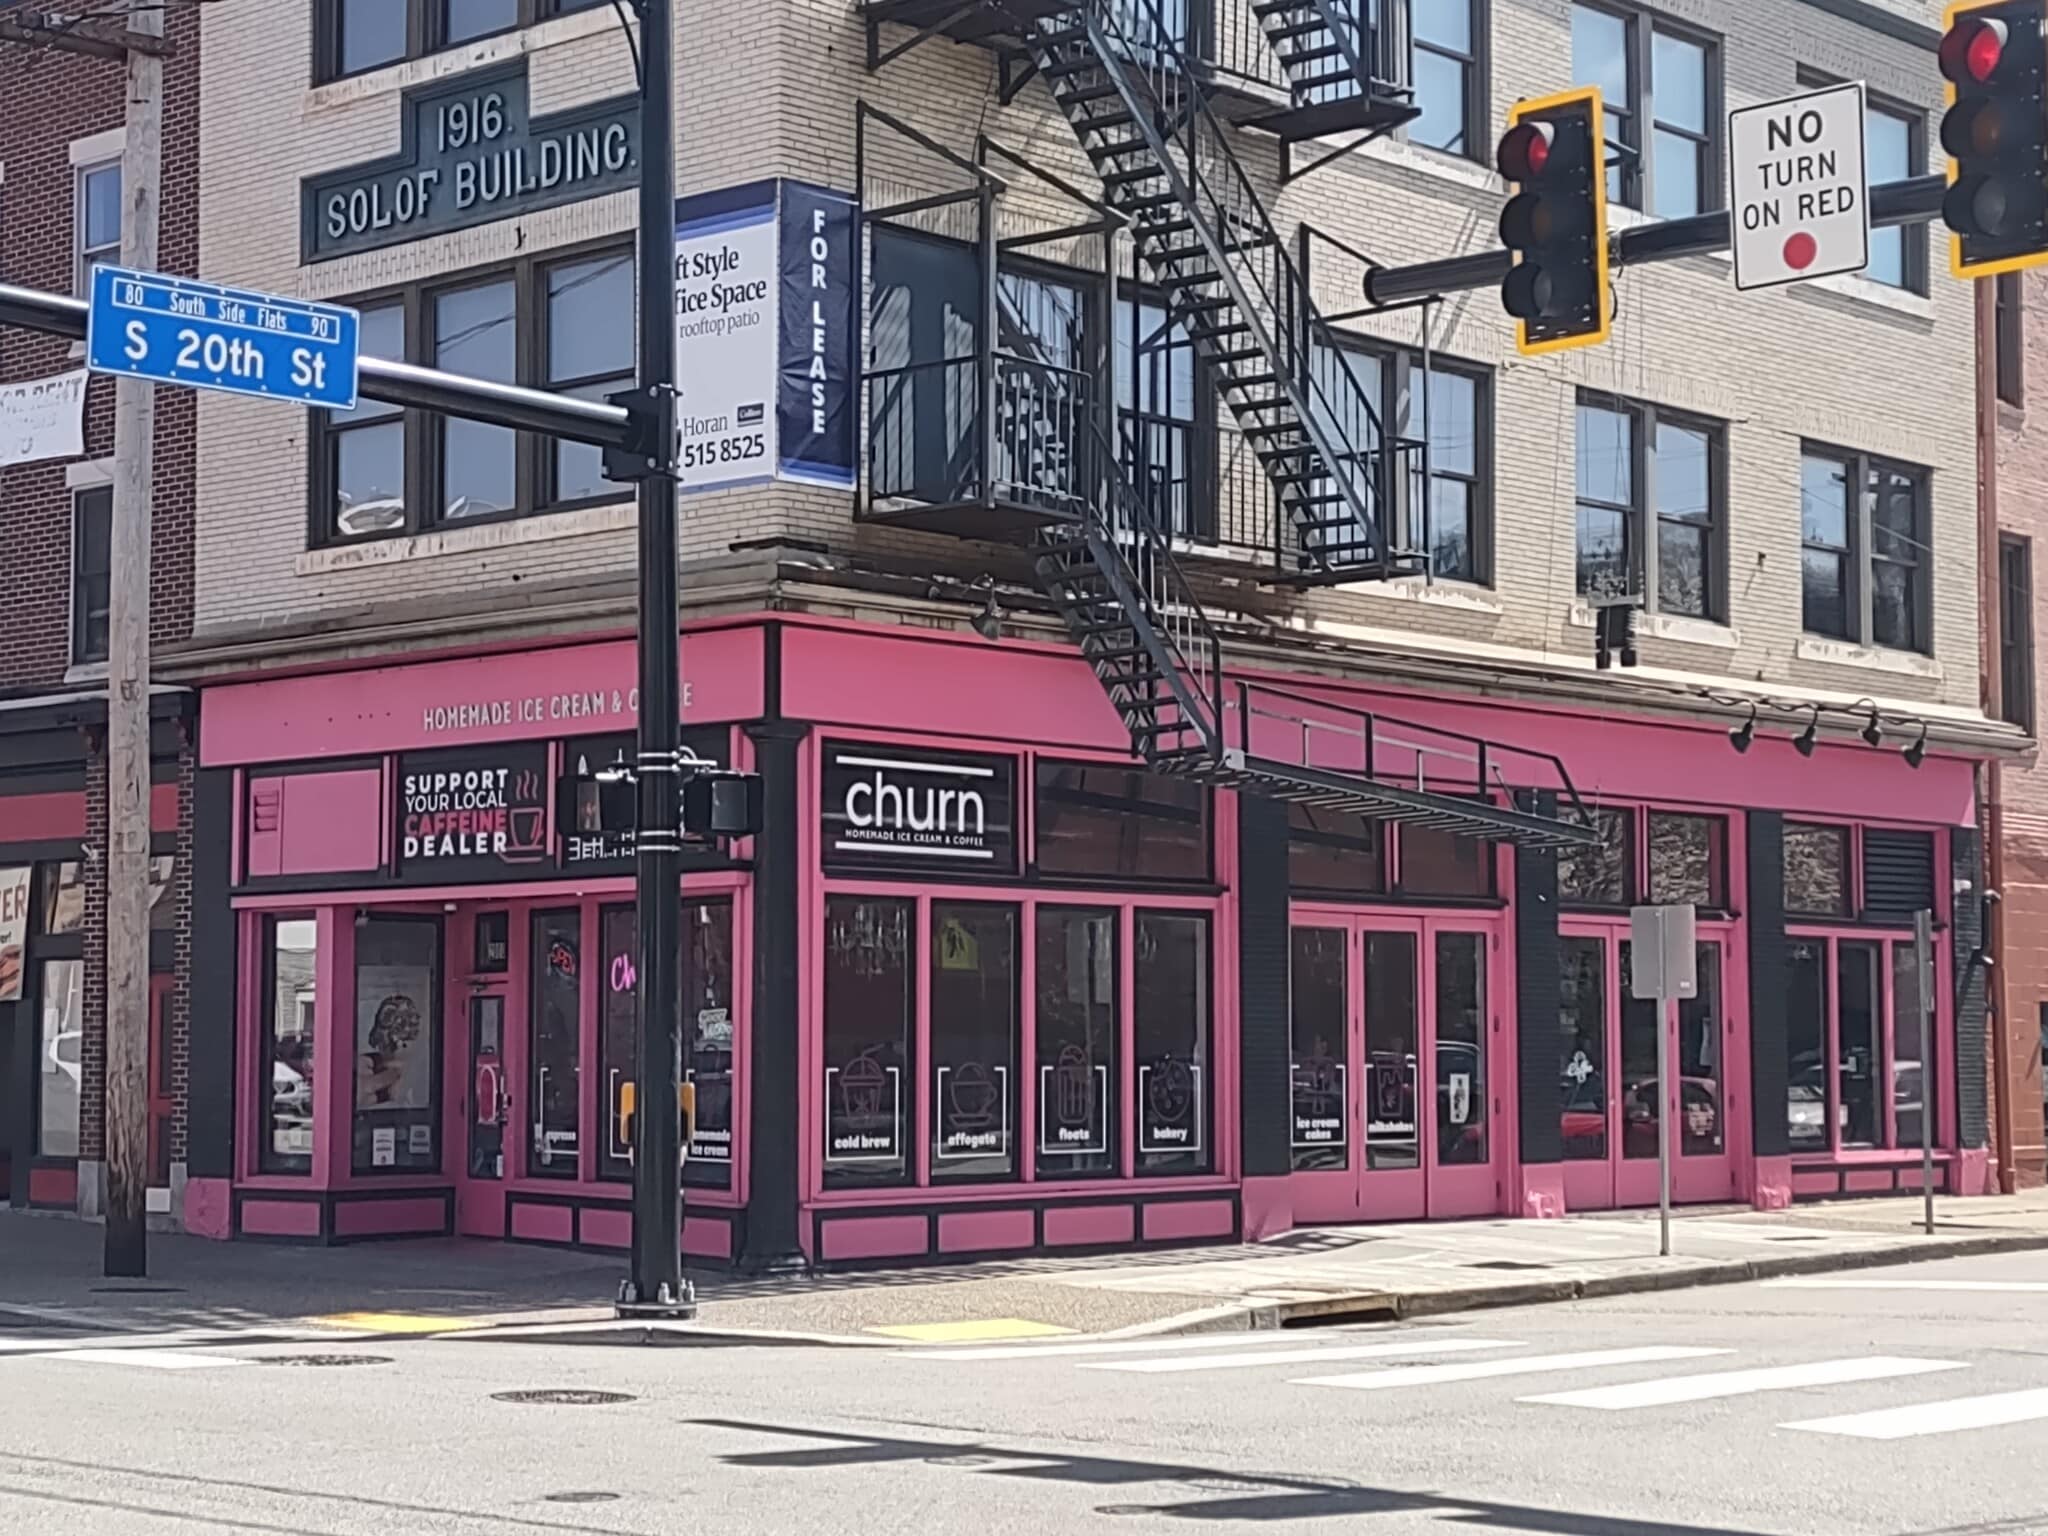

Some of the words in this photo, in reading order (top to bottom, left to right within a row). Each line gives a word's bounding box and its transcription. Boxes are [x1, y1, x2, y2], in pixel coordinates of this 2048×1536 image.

[1768, 110, 1823, 151] NO
[1758, 150, 1836, 189] TURN
[328, 168, 439, 239] SOLOF
[1743, 199, 1780, 230] ON
[1799, 186, 1854, 220] RED
[675, 254, 690, 281] ft
[692, 246, 740, 281] Style
[810, 209, 828, 289] FOR
[125, 284, 143, 306] 80
[170, 292, 206, 317] South
[218, 301, 245, 324] Side
[257, 308, 287, 331] Flats
[311, 318, 328, 337] 90
[710, 280, 767, 313] Space
[680, 316, 725, 338] rooftop
[727, 309, 760, 335] patio
[124, 320, 148, 360] S
[176, 328, 264, 379] 20th
[291, 348, 326, 389] St
[809, 301, 827, 434] LEASE
[683, 415, 728, 437] Horan
[685, 441, 716, 467] 515
[720, 434, 765, 462] 8525
[424, 700, 511, 731] HOMEMADE
[519, 698, 543, 721] ICE
[551, 695, 605, 720] CREAM
[612, 690, 621, 713] &
[405, 769, 509, 795] SUPPORT
[405, 793, 449, 813] YOUR
[455, 790, 507, 810] LOCAL
[846, 771, 984, 834] churn
[405, 809, 507, 836] CAFFEINE
[845, 829, 894, 841] HOMEMADE
[897, 832, 911, 842] ICE
[913, 833, 942, 843] CREAM
[953, 835, 983, 846] COFFEE
[404, 831, 507, 858] DEALER
[0, 884, 26, 922] ER
[1153, 1126, 1188, 1142] bakery
[1296, 1116, 1311, 1128] ice
[834, 1135, 859, 1149] cold
[861, 1136, 891, 1149] brew
[948, 1131, 996, 1149] affogato
